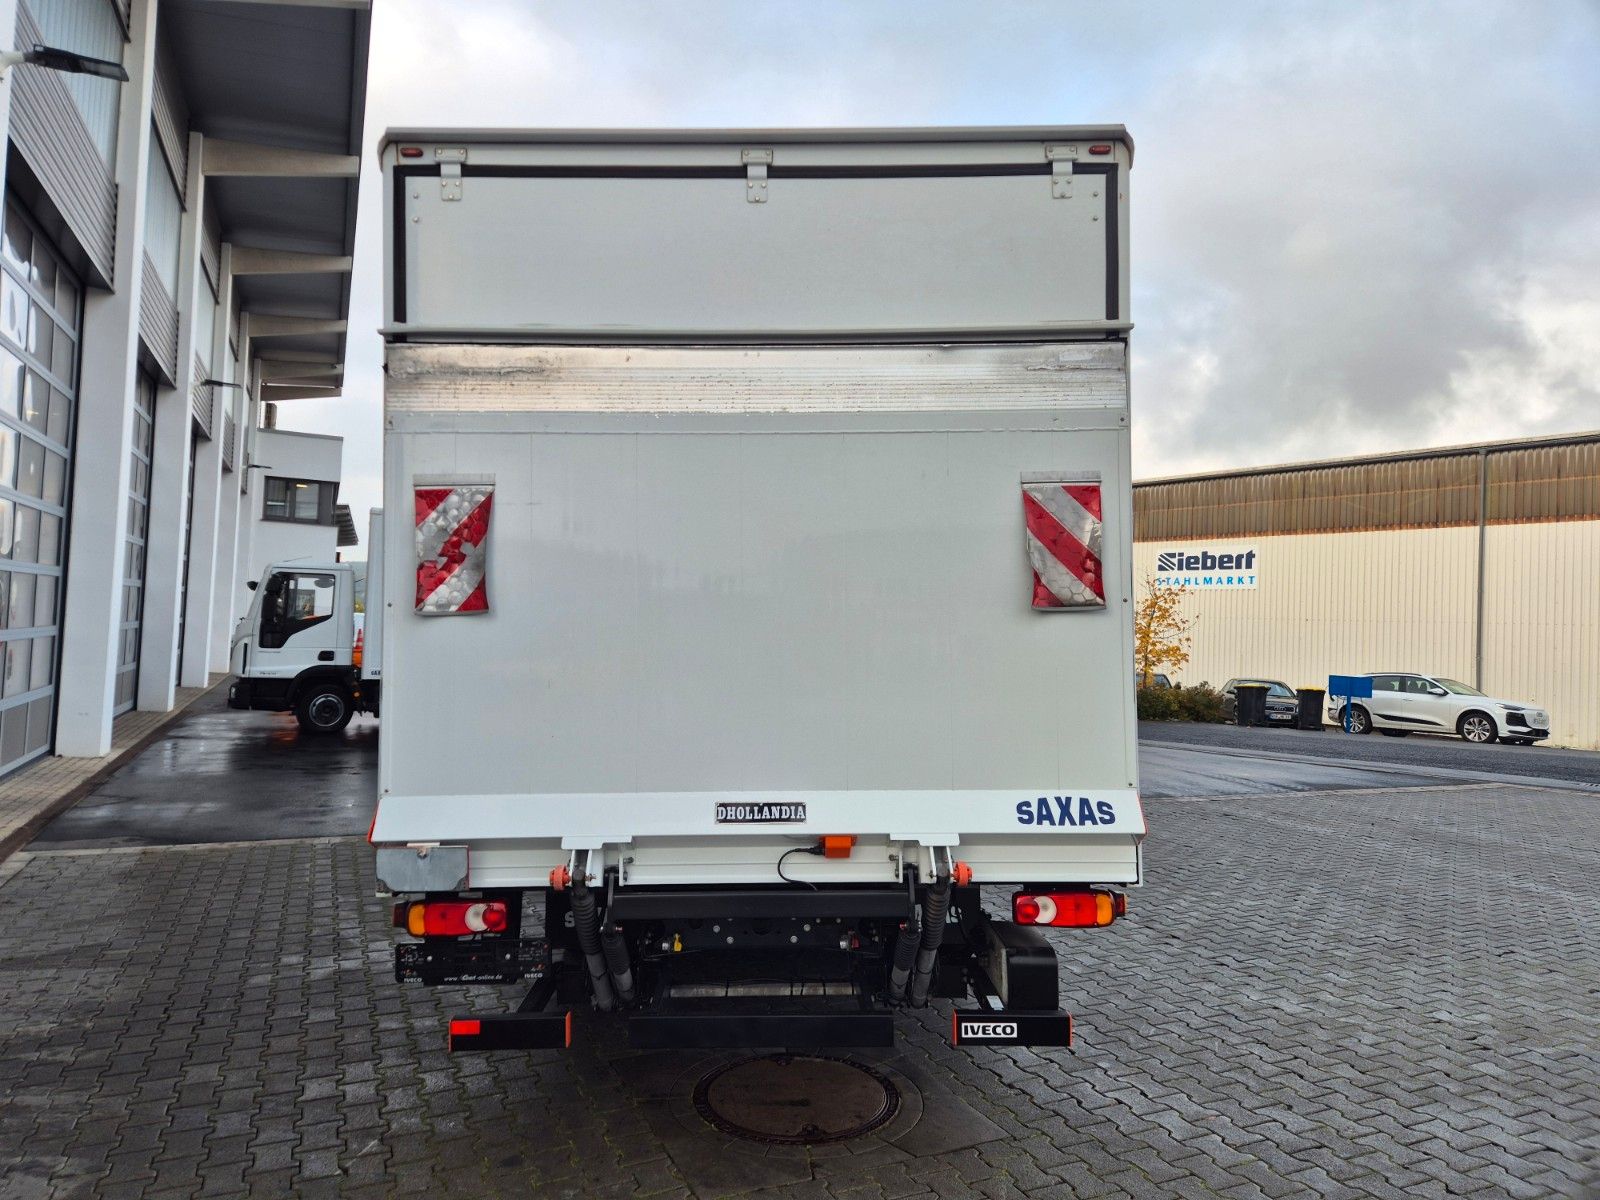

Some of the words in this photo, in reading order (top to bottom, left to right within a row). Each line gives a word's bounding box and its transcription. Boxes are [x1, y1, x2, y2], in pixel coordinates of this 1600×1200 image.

[1158, 550, 1256, 571] Siebert
[1157, 576, 1256, 586] STAHLMARKT
[717, 806, 806, 820] DHOLLANDIA
[1016, 796, 1116, 826] SAXAS
[963, 1025, 1015, 1036] IVECO
